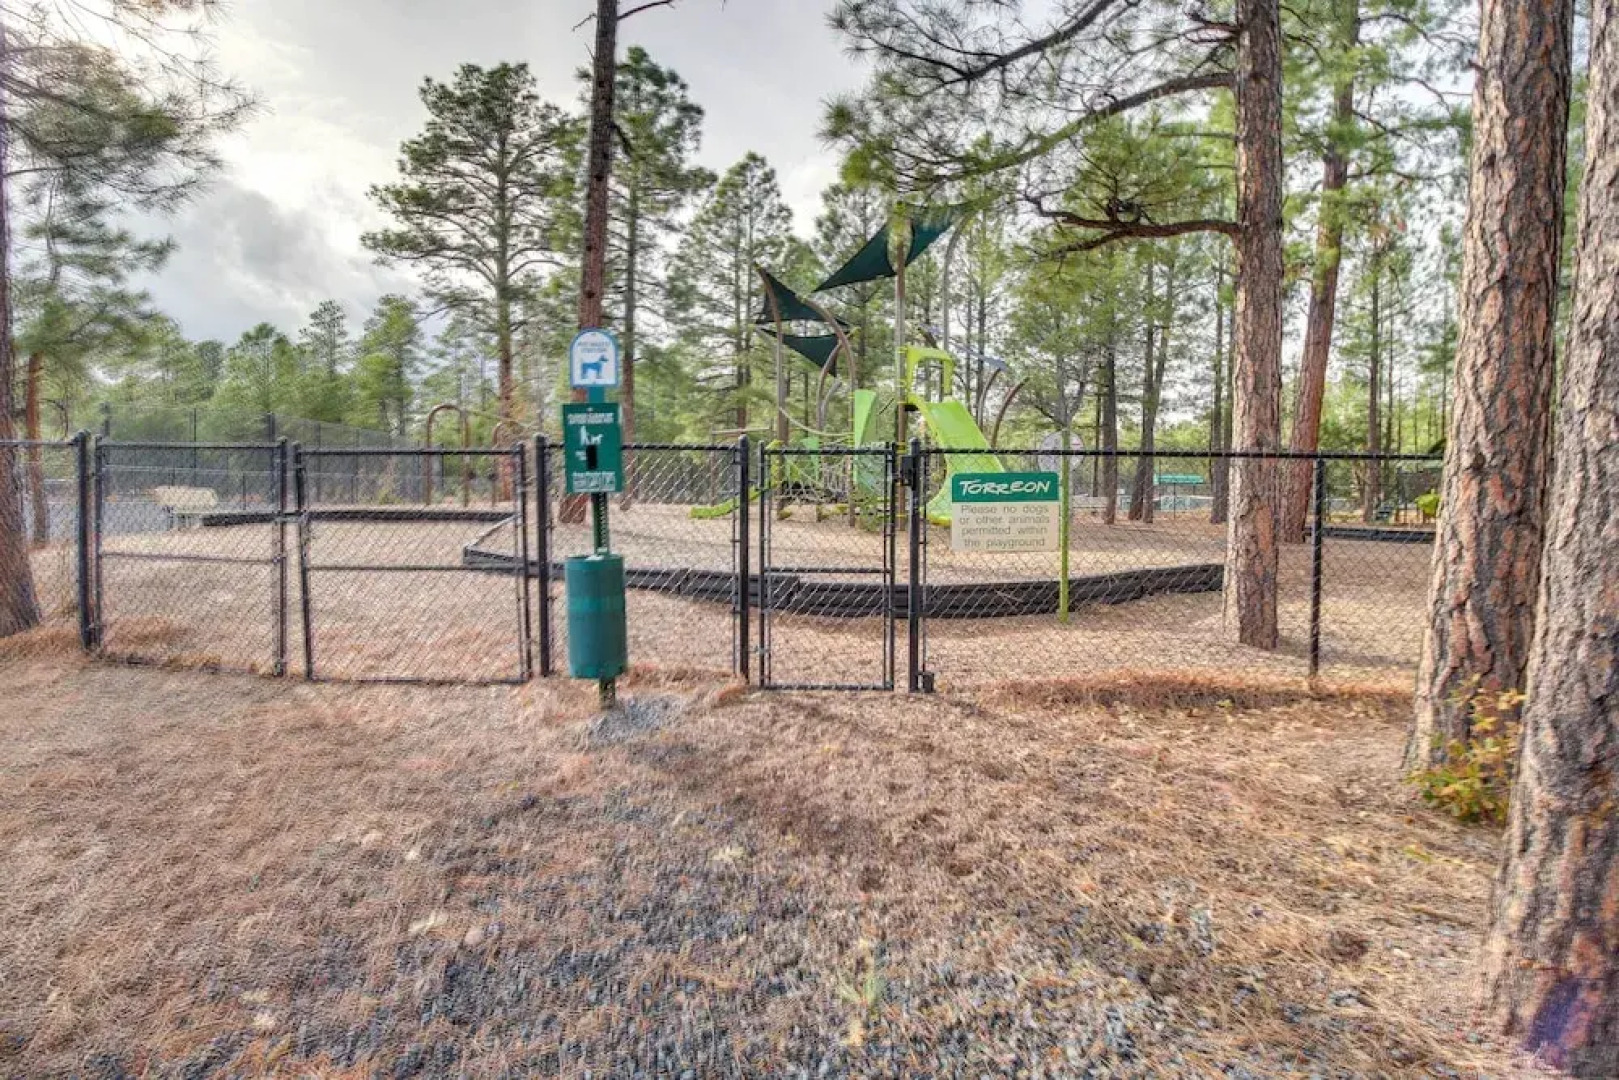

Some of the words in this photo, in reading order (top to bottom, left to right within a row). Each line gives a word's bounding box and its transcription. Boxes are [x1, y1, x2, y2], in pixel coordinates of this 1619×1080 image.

[959, 479, 1050, 496] TORREON
[961, 505, 997, 513] Please
[1022, 505, 1050, 515] dogs
[960, 517, 970, 525] or
[975, 516, 1003, 524] other
[961, 526, 1011, 536] permitted
[1017, 526, 1048, 535] within
[964, 538, 980, 546] the
[985, 538, 1045, 549] playground
